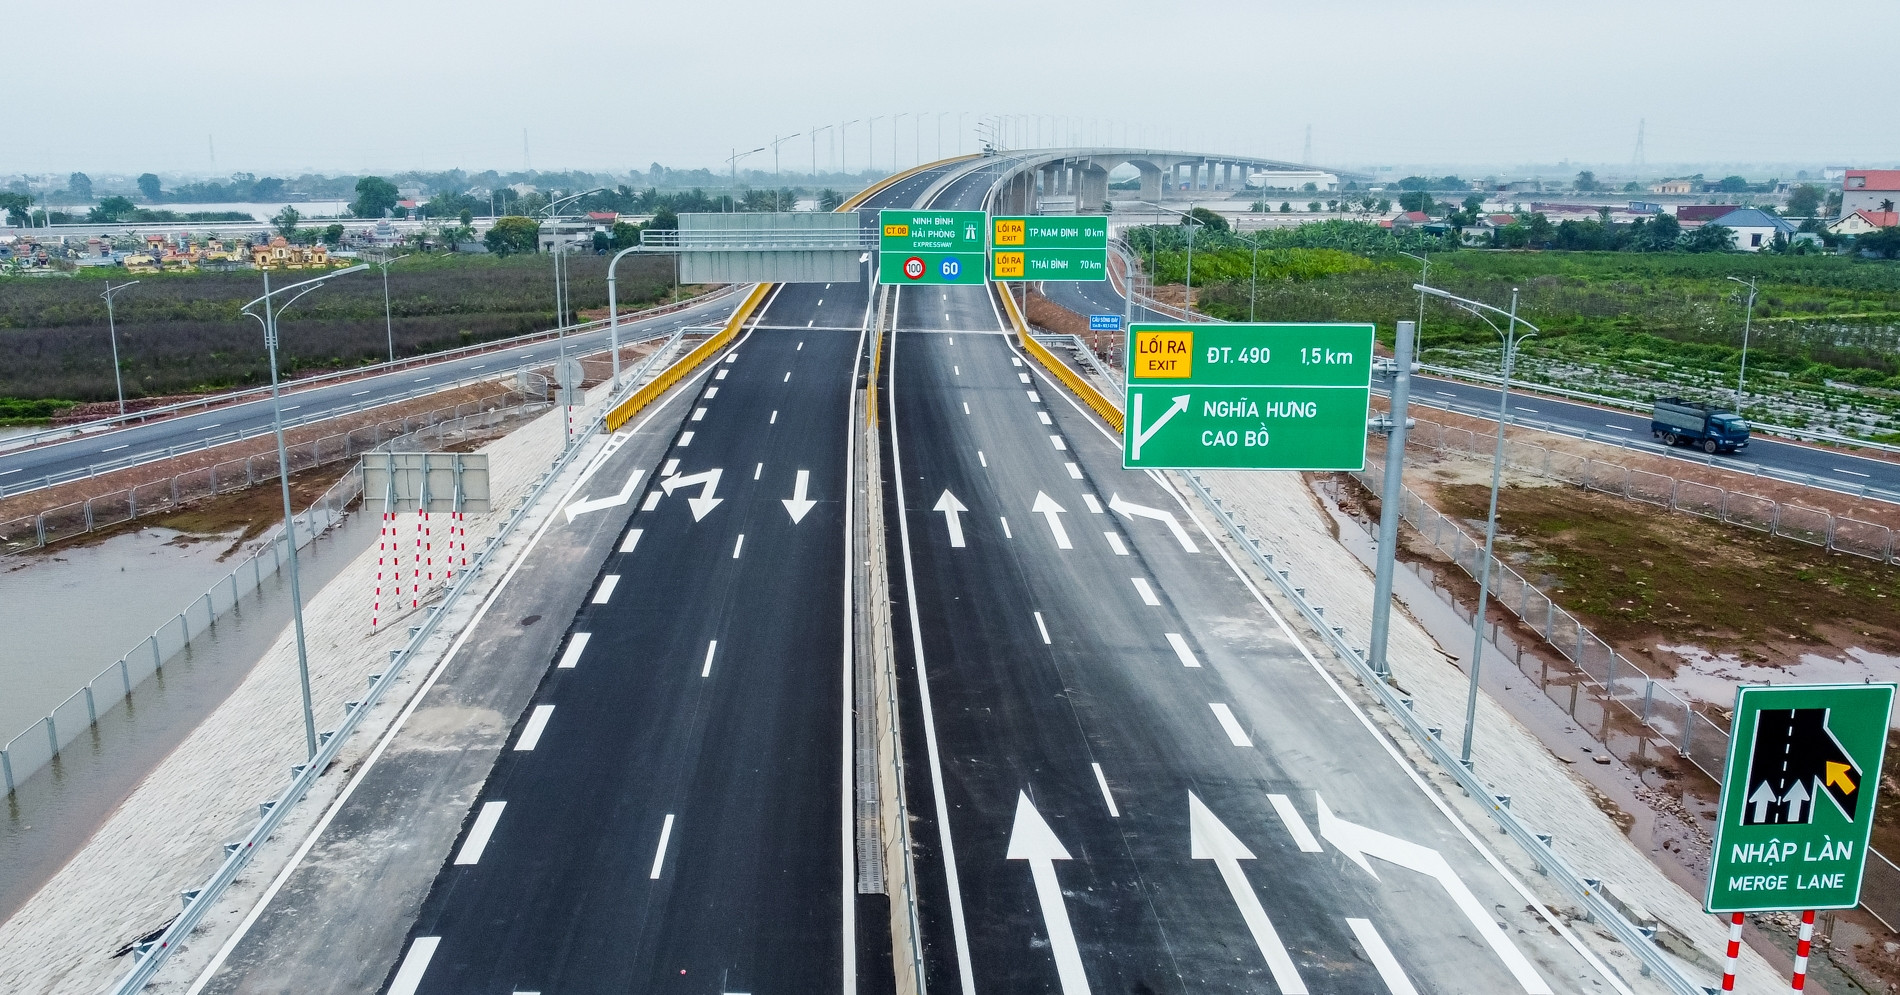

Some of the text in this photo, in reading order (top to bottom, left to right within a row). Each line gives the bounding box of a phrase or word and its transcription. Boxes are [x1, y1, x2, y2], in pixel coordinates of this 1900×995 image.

[934, 216, 954, 225] BÌNH
[998, 222, 1010, 232] LỐI
[912, 228, 955, 238] HẢI PHÒNG
[1060, 228, 1078, 239] ĐỊNH
[1084, 228, 1091, 237] 10
[1092, 228, 1104, 237] km
[997, 254, 1009, 264] LỐI
[1031, 258, 1101, 269] THÁI BÌNH 70 km
[908, 264, 921, 273] 100
[942, 262, 958, 275] 60
[1140, 334, 1186, 354] LỐI RA
[1207, 347, 1352, 366] ĐT. 490 1,5 km
[1149, 360, 1177, 370] EXIT
[1204, 397, 1317, 418] NGHĨA HƯNG
[1201, 422, 1269, 447] CAO BỒ
[1731, 834, 1853, 866] NHẬP LÀN
[1728, 874, 1845, 891] MERGE LANE
